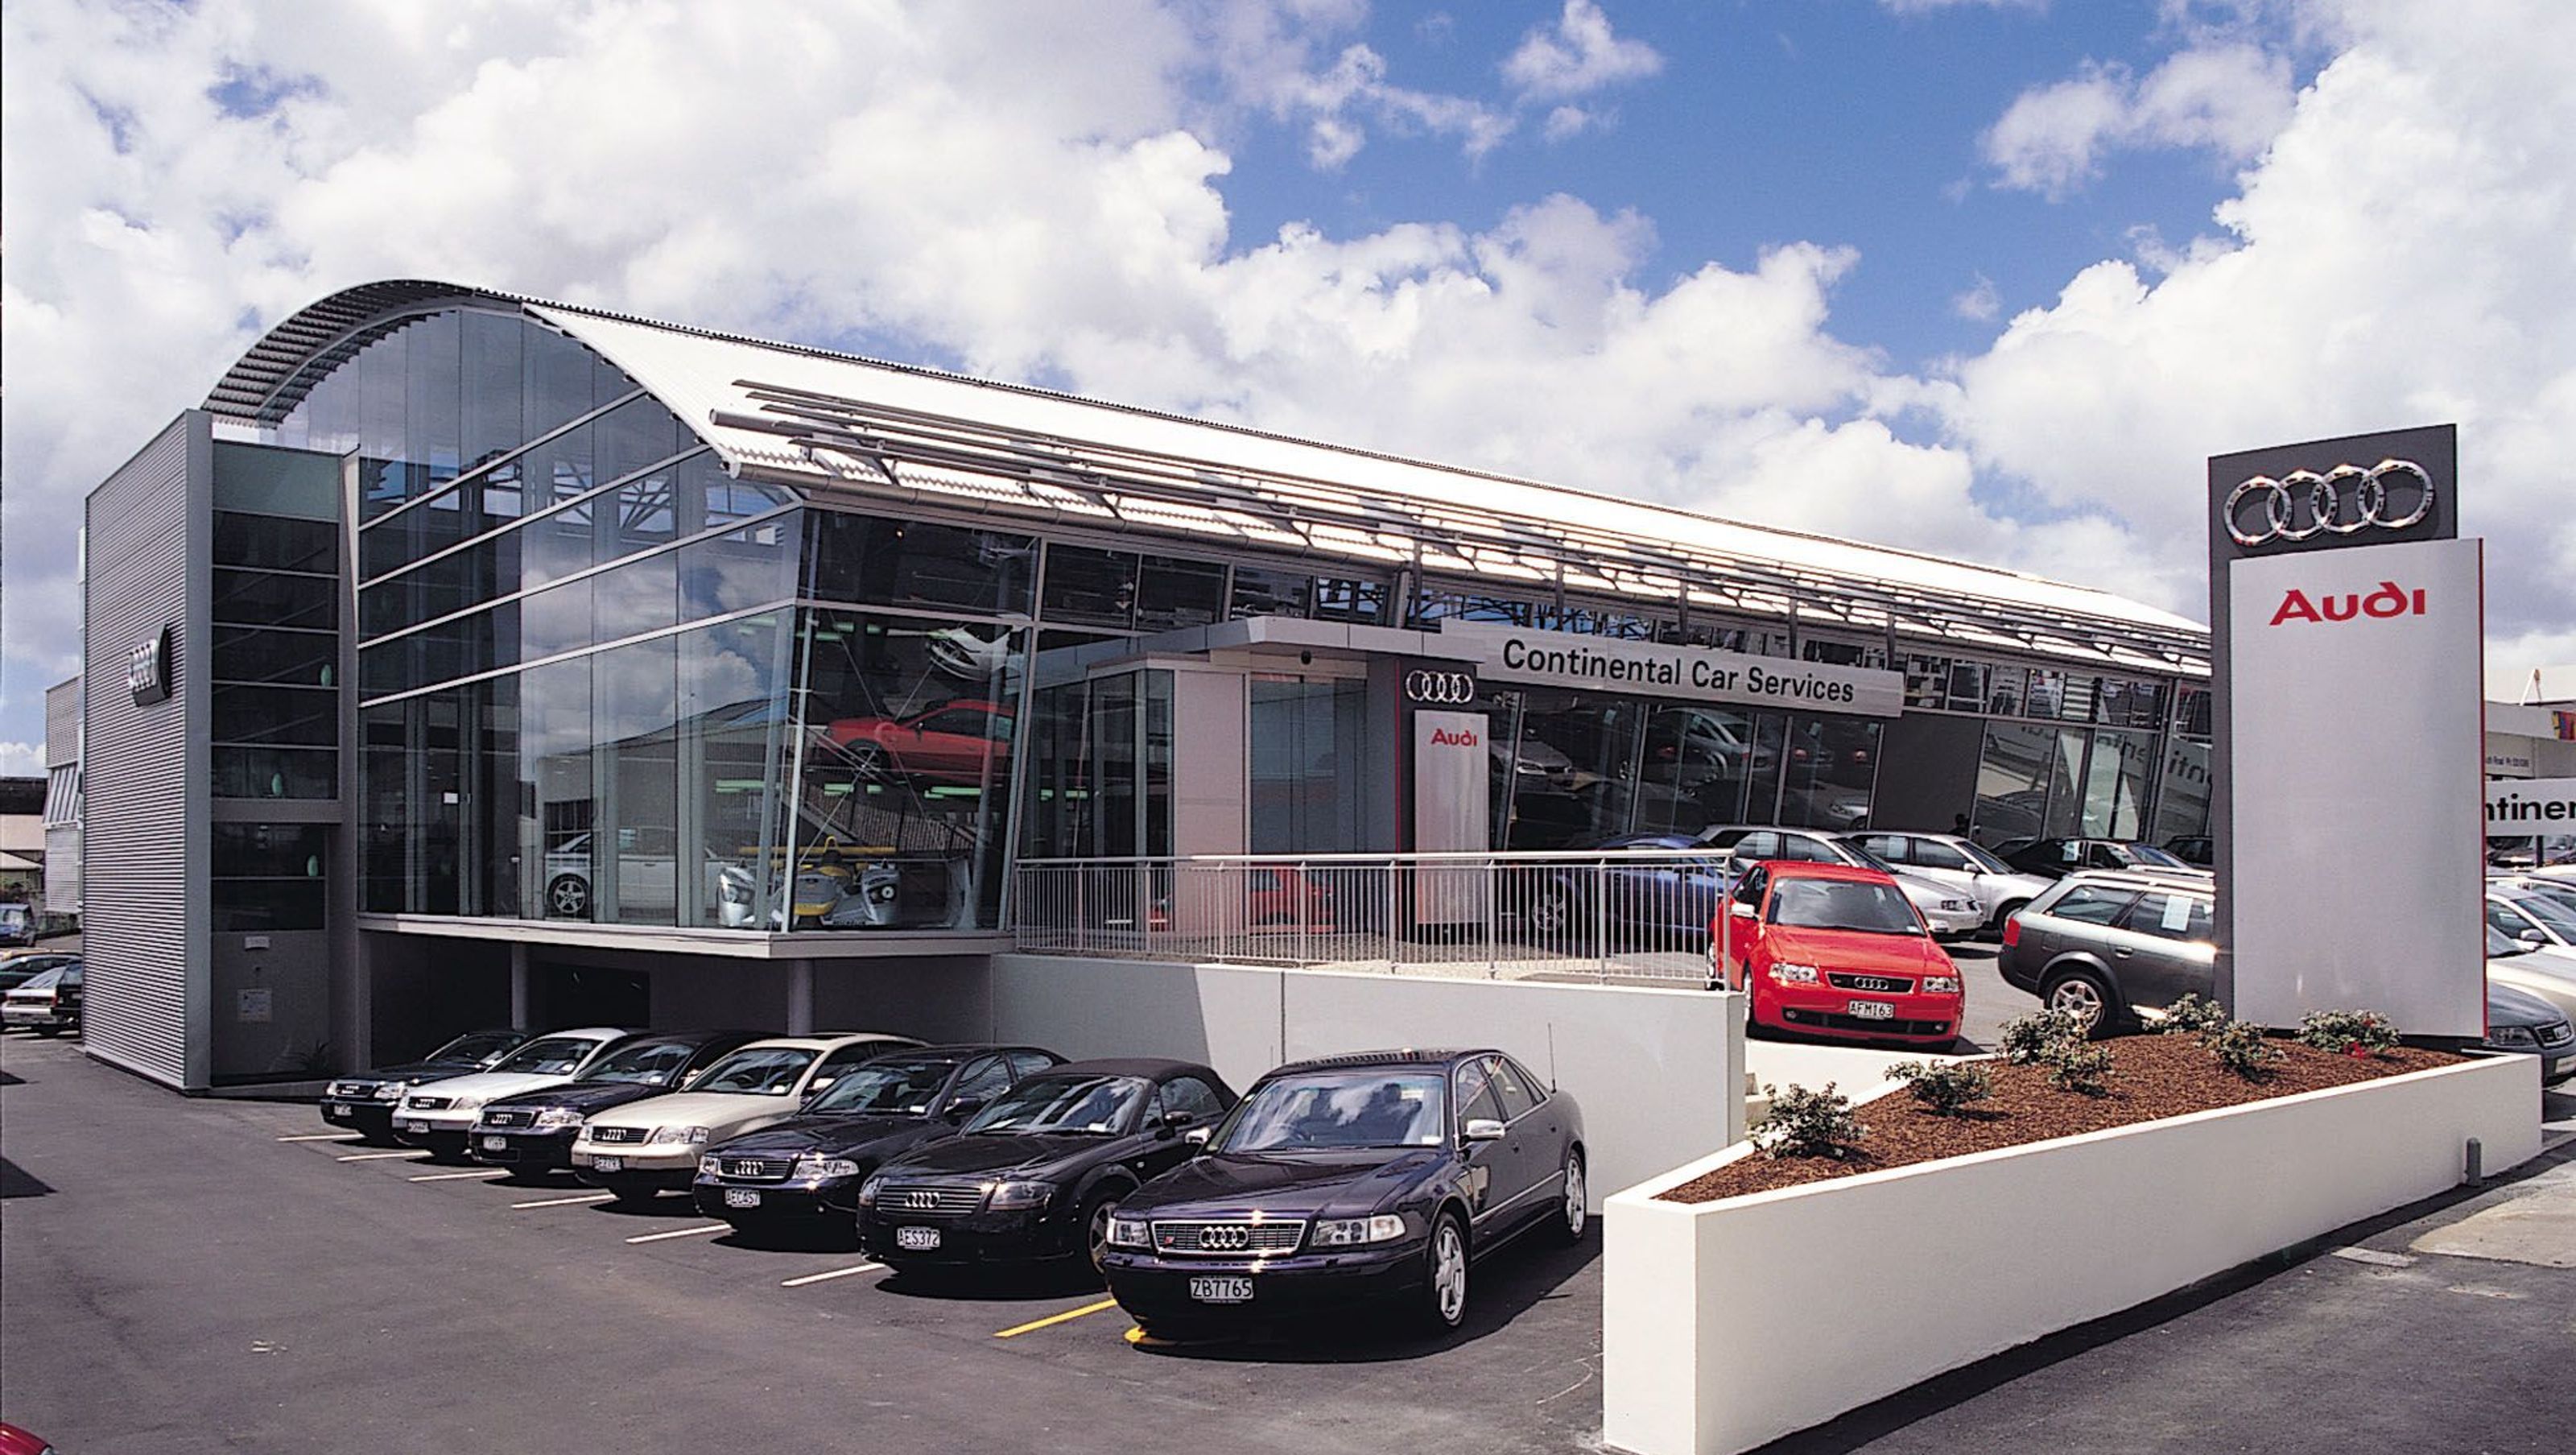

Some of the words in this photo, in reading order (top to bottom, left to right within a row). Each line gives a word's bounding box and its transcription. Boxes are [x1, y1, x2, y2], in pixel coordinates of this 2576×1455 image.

[2268, 581, 2426, 626] Audi
[1503, 639, 1681, 685] Continental
[1691, 659, 1739, 690] Car
[1747, 666, 1855, 703] Services
[1430, 727, 1478, 747] Audi
[1849, 1001, 1893, 1017] AFM163
[1191, 1279, 1253, 1297] ZB7765
